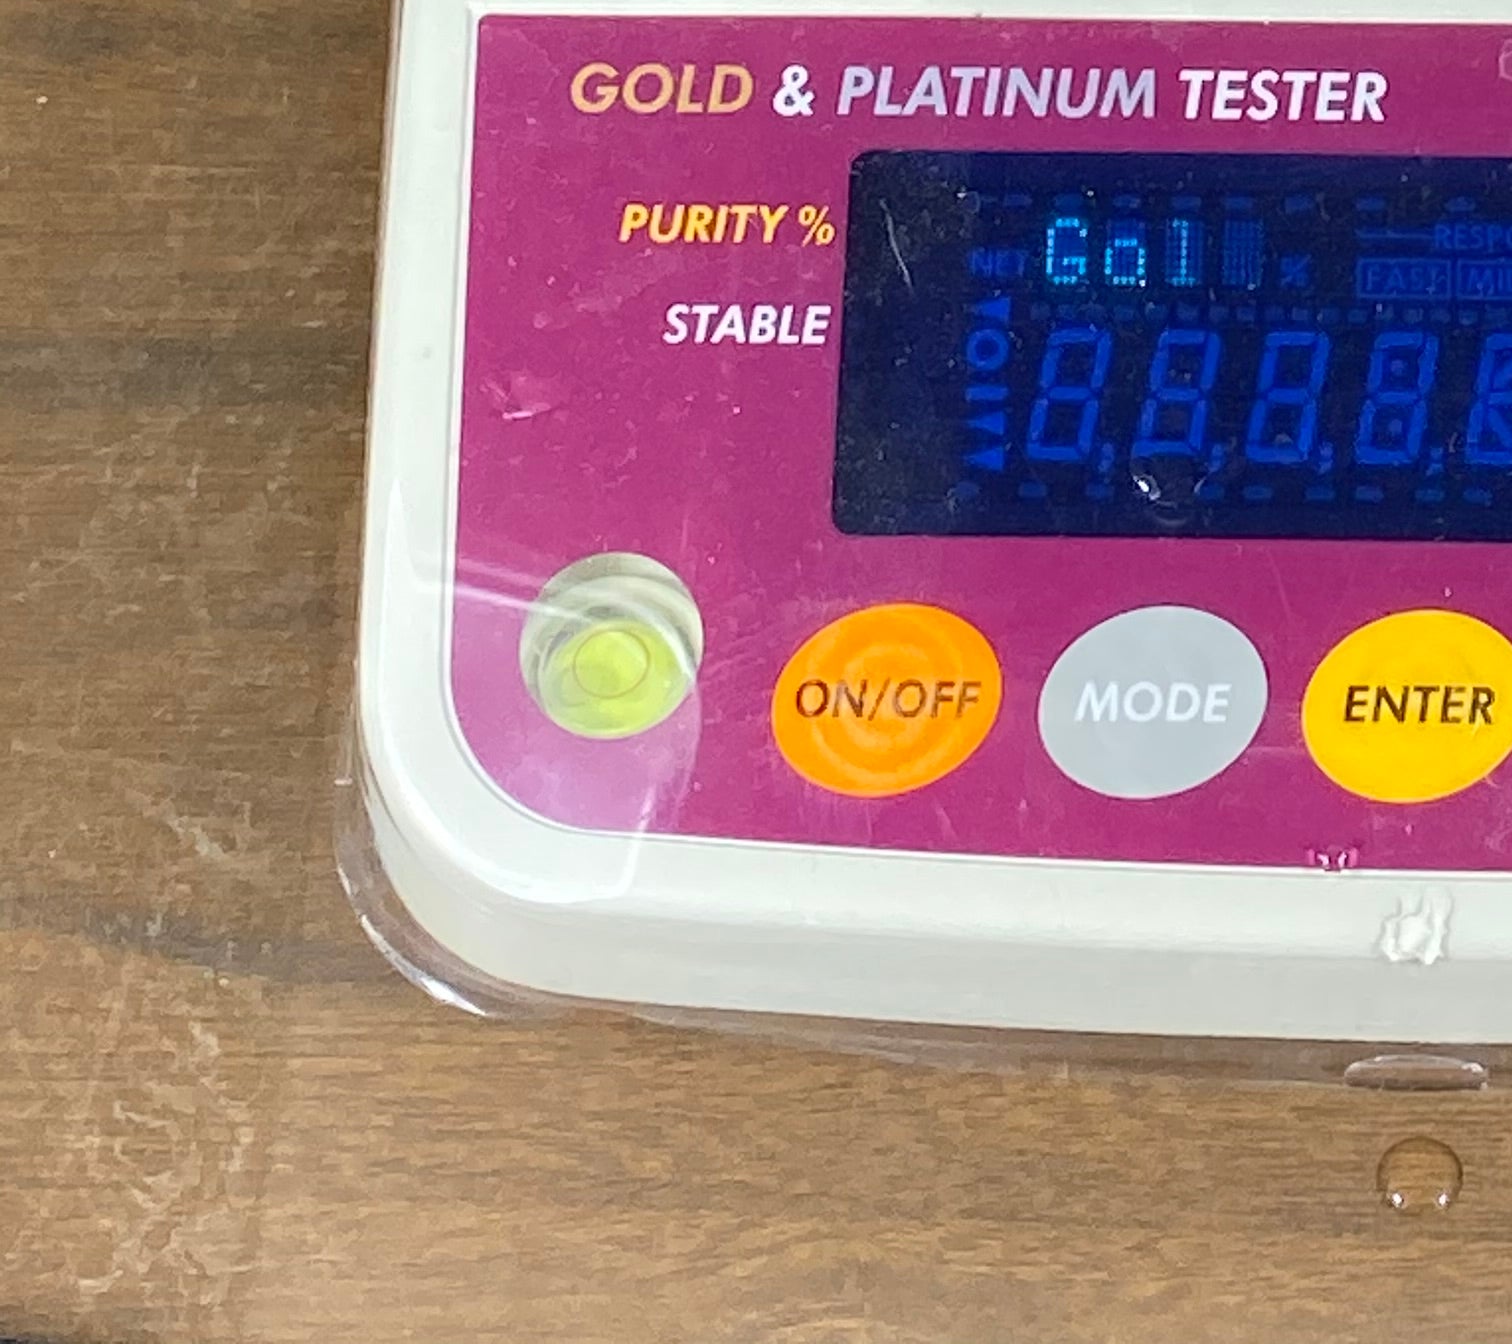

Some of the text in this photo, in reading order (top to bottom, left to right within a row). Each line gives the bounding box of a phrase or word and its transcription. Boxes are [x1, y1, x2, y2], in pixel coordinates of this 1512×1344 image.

[570, 63, 1389, 122] GOLD & PLATINUM TESTER
[618, 204, 836, 246] PURITY %
[663, 303, 831, 344] STABLE
[795, 679, 982, 719] ON/OFF
[1074, 682, 1231, 724] MODE
[1343, 686, 1496, 725] ENTER
